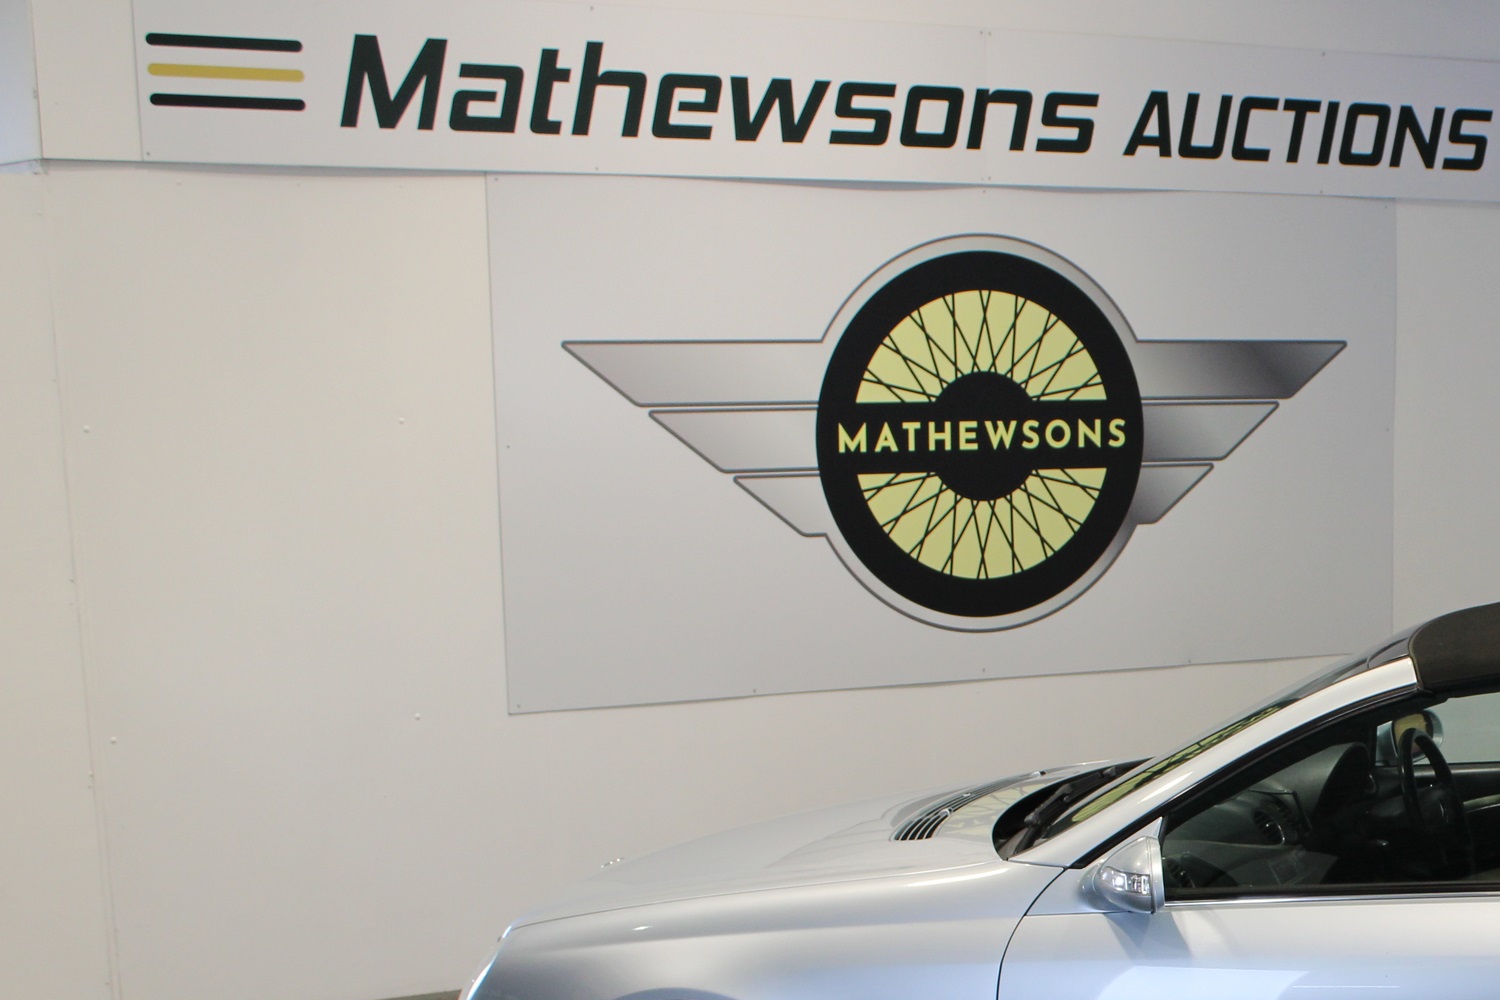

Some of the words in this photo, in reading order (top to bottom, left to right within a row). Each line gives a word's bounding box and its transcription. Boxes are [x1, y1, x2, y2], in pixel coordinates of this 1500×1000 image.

[340, 34, 1100, 154] Mathewsons
[1122, 90, 1494, 172] AUCTIONS
[837, 418, 1127, 454] MATHEWSONS
